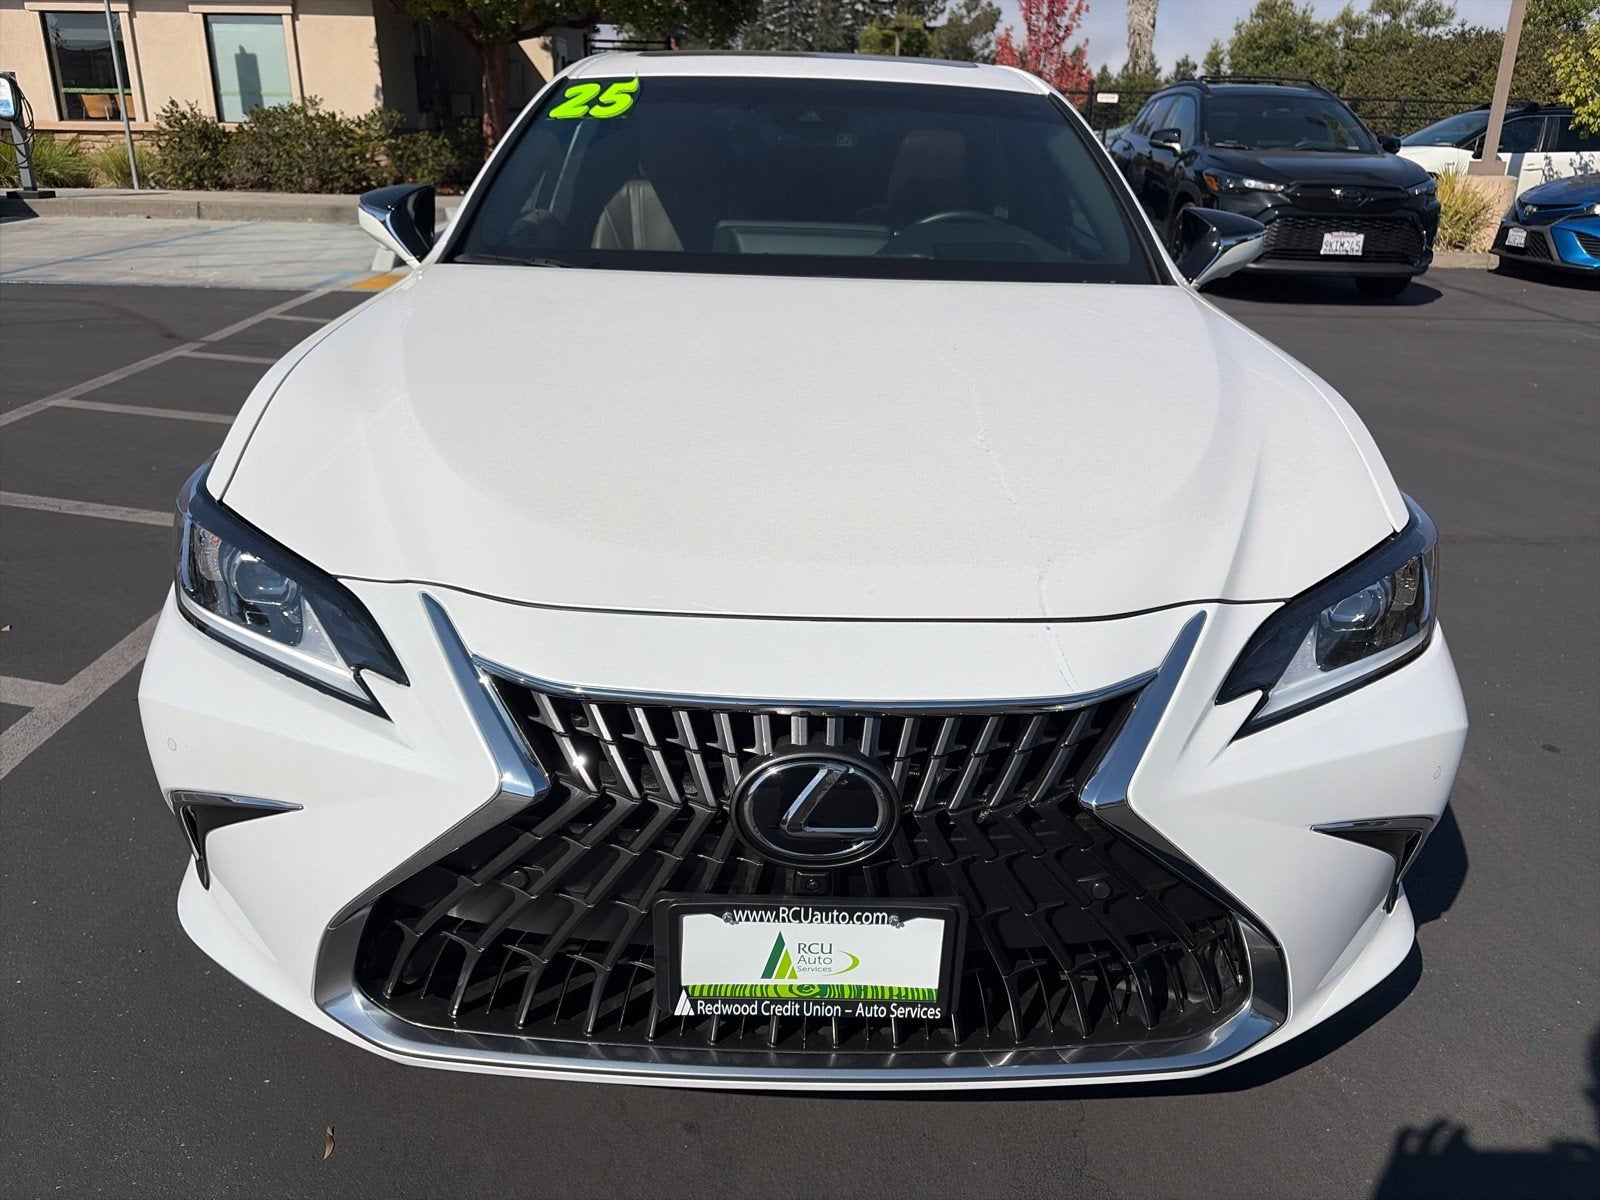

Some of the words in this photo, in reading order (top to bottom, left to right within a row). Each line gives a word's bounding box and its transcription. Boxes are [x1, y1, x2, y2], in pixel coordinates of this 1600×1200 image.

[549, 77, 639, 119] 25
[733, 907, 888, 924] www.RCUauto.com
[797, 943, 833, 955] RCU
[797, 954, 833, 965] Auto
[796, 965, 832, 973] Services
[697, 1000, 758, 1016] Redwood
[761, 1001, 800, 1017] Credit
[803, 1002, 842, 1017] Union
[855, 1002, 887, 1018] Auto
[889, 1003, 941, 1019] Services
